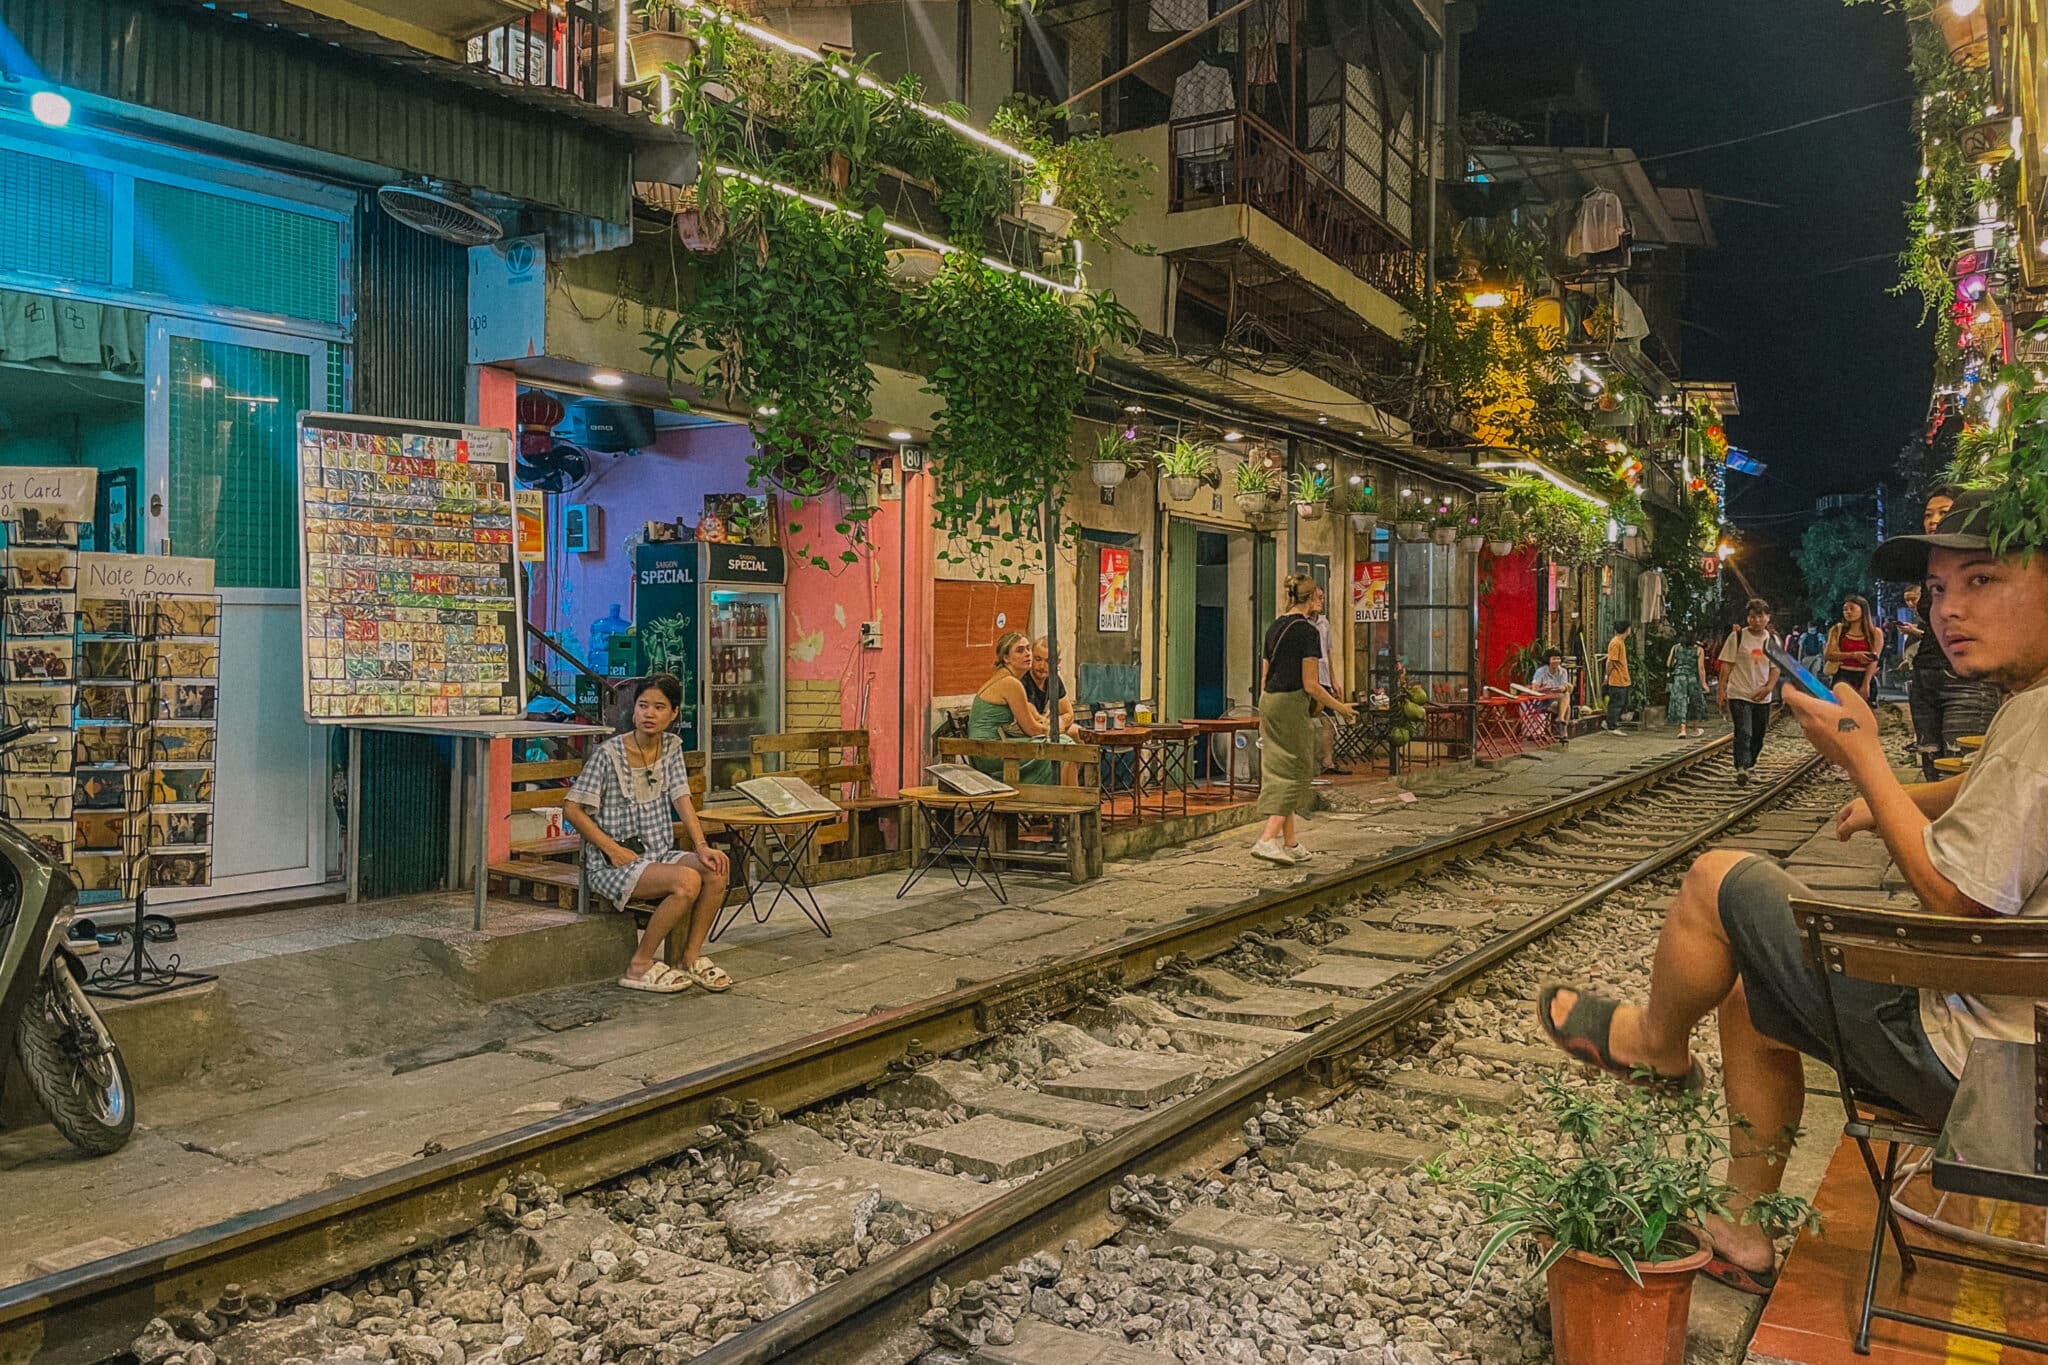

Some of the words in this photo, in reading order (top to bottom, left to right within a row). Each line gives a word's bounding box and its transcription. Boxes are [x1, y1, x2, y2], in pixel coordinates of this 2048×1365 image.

[906, 449, 921, 467] 80
[24, 477, 62, 499] Card
[738, 553, 758, 561] SAIGON
[655, 560, 679, 569] SAIGON
[727, 559, 769, 572] SPECIAL
[89, 563, 135, 587] Note
[143, 563, 192, 587] Books
[640, 568, 694, 585] SPECIAL
[1101, 614, 1112, 628] BIA
[1355, 610, 1371, 620] BIA
